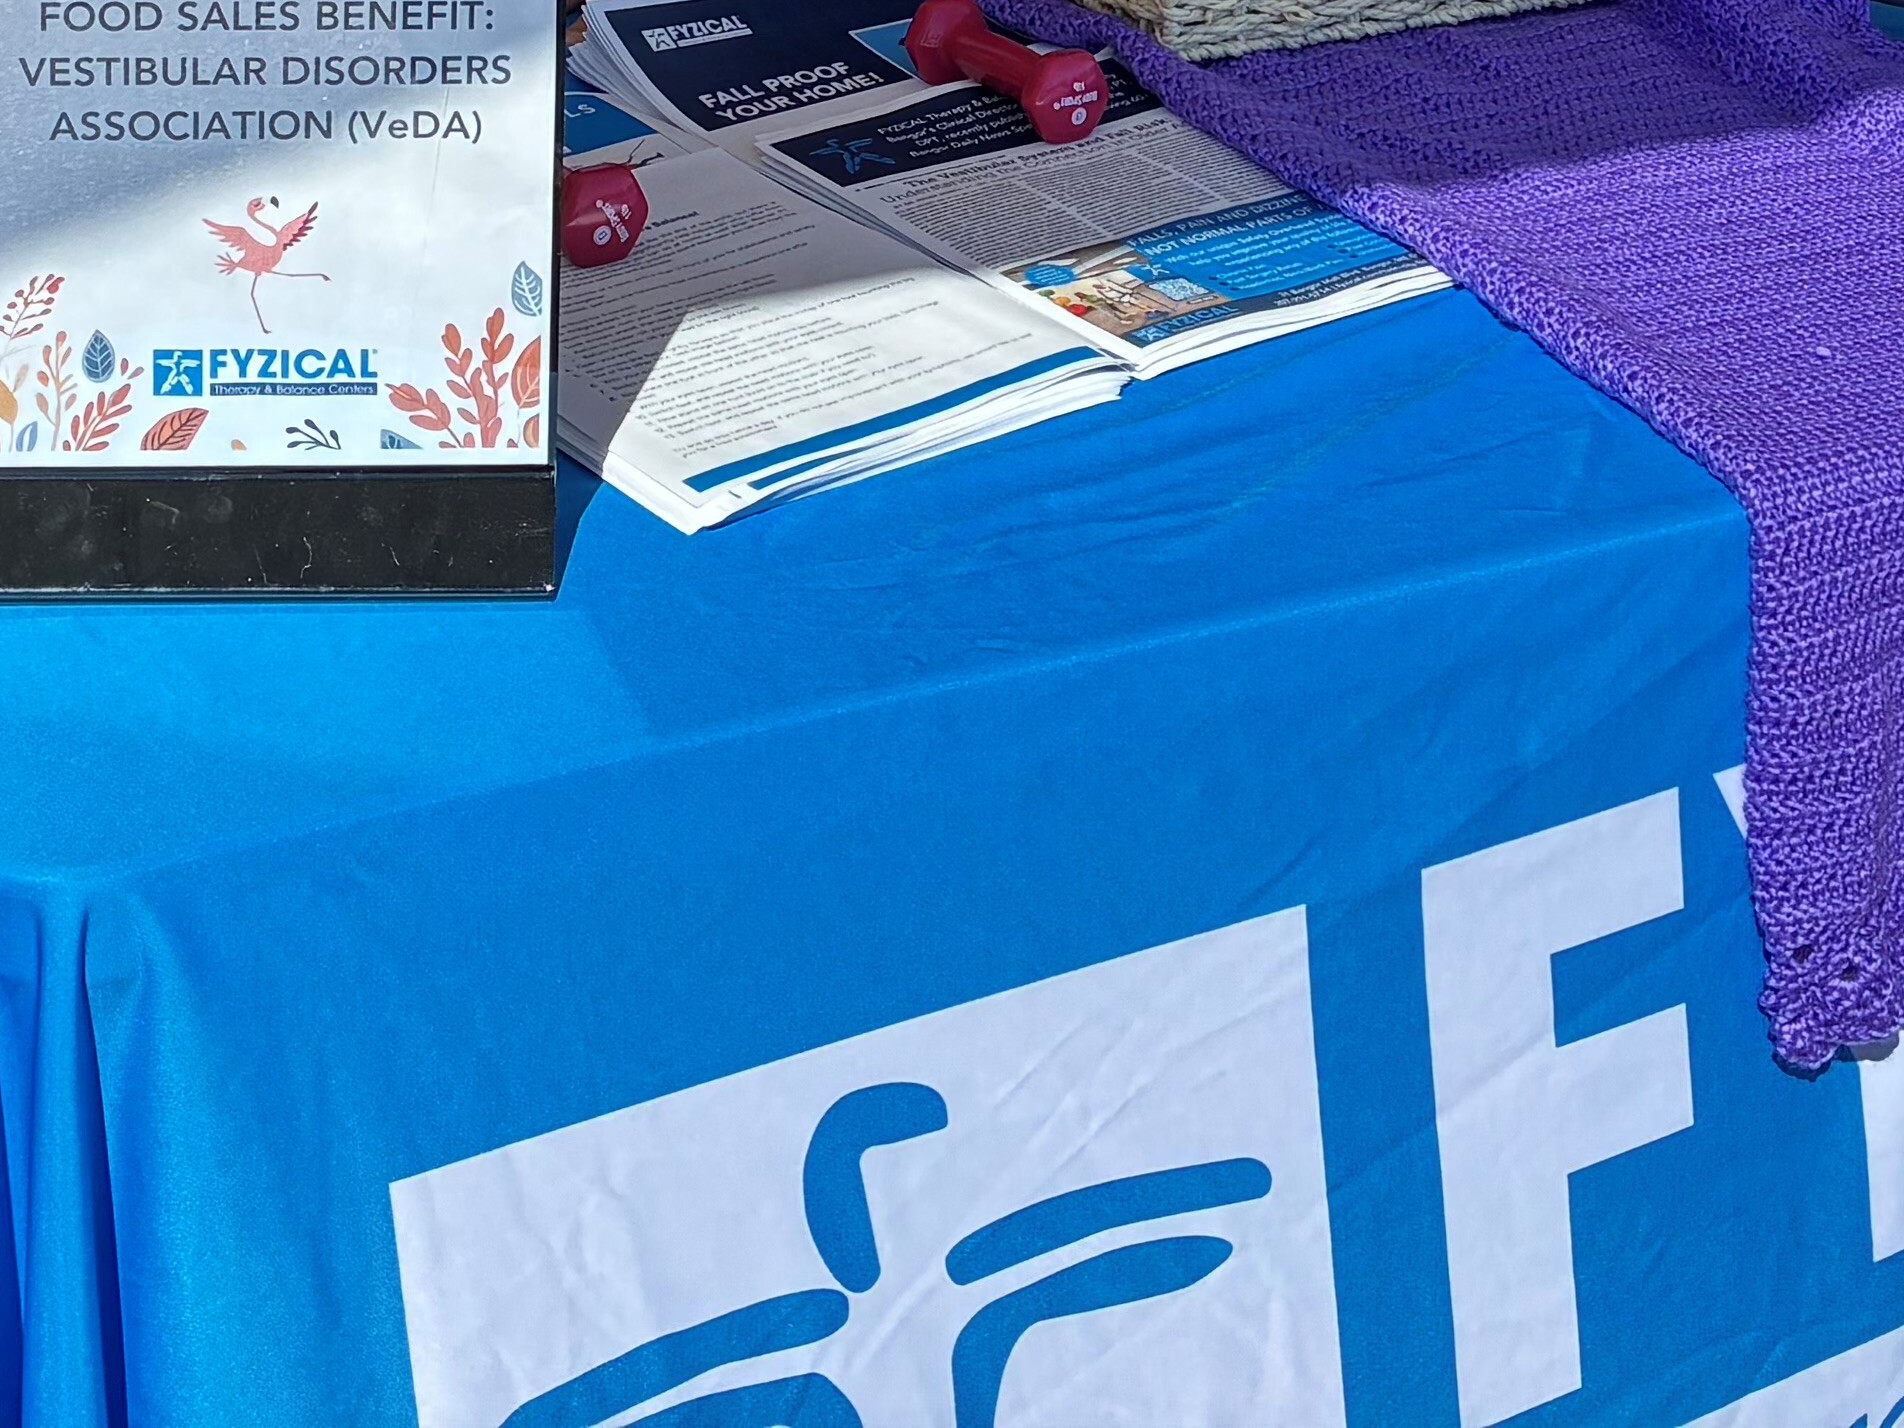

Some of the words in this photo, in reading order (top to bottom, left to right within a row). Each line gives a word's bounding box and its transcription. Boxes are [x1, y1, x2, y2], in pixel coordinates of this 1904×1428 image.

[39, 1, 164, 33] FOOD
[177, 0, 302, 33] SALES
[315, 0, 495, 32] BENEFIT:
[665, 14, 749, 42] FYZICAL
[18, 56, 268, 88] VESTIBULAR
[281, 54, 513, 87] DISORDERS
[698, 86, 767, 110] FALL
[762, 61, 851, 93] PROOF
[715, 95, 796, 123] YOUR
[792, 71, 885, 104] HOME!
[48, 109, 333, 143] ASSOCIATION
[347, 107, 484, 146] (VeDA)
[1144, 239, 1180, 256] NOT
[1182, 221, 1245, 246] NORMAL
[1245, 211, 1293, 232] PARTS
[1293, 204, 1314, 218] OF
[1180, 218, 1215, 236] PAIN
[1215, 207, 1250, 226] AND
[1162, 304, 1242, 334] FYZICAL
[209, 348, 379, 380] FYZICAL
[214, 384, 261, 397] Therapy
[264, 384, 273, 394] &
[276, 384, 326, 395] Balance
[328, 383, 374, 395] Centers
